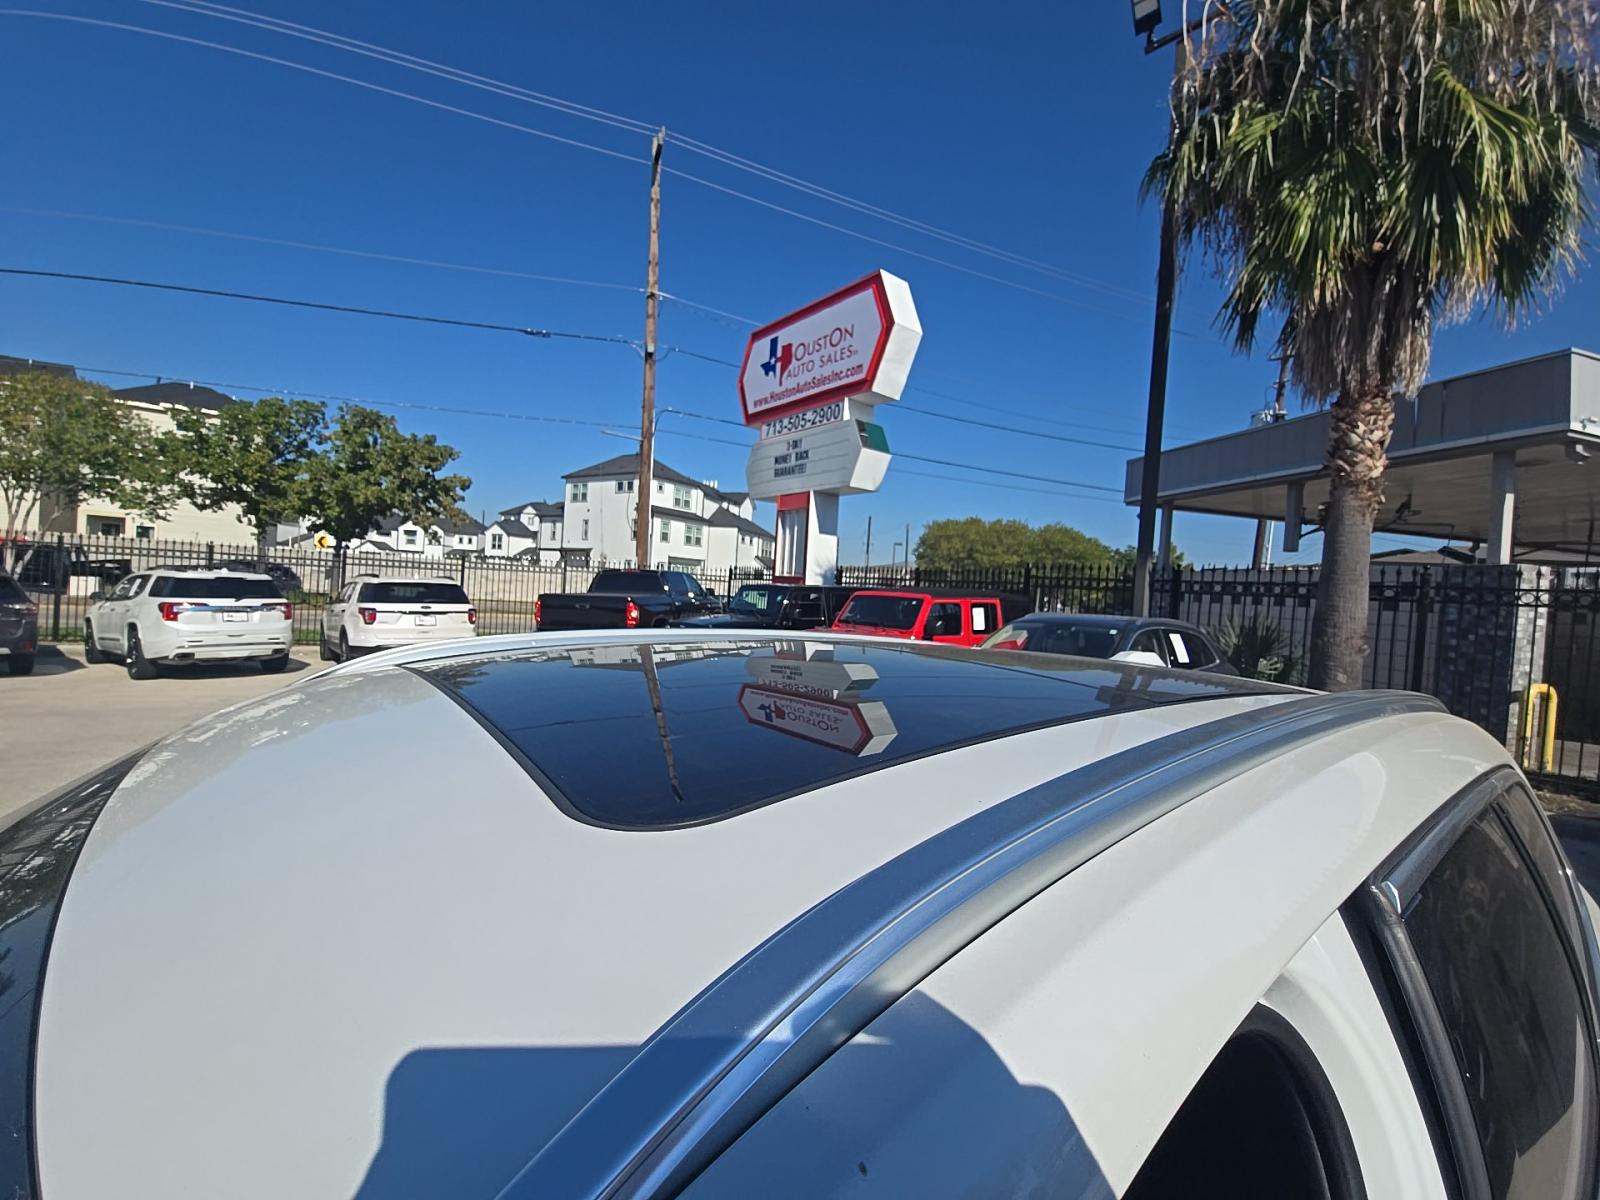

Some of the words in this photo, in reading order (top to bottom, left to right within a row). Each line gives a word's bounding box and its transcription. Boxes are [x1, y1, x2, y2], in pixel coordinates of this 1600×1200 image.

[785, 360, 815, 380] AUTO
[818, 345, 853, 368] SALES
[766, 404, 841, 437] 713-505-2900
[795, 448, 810, 462] BACK
